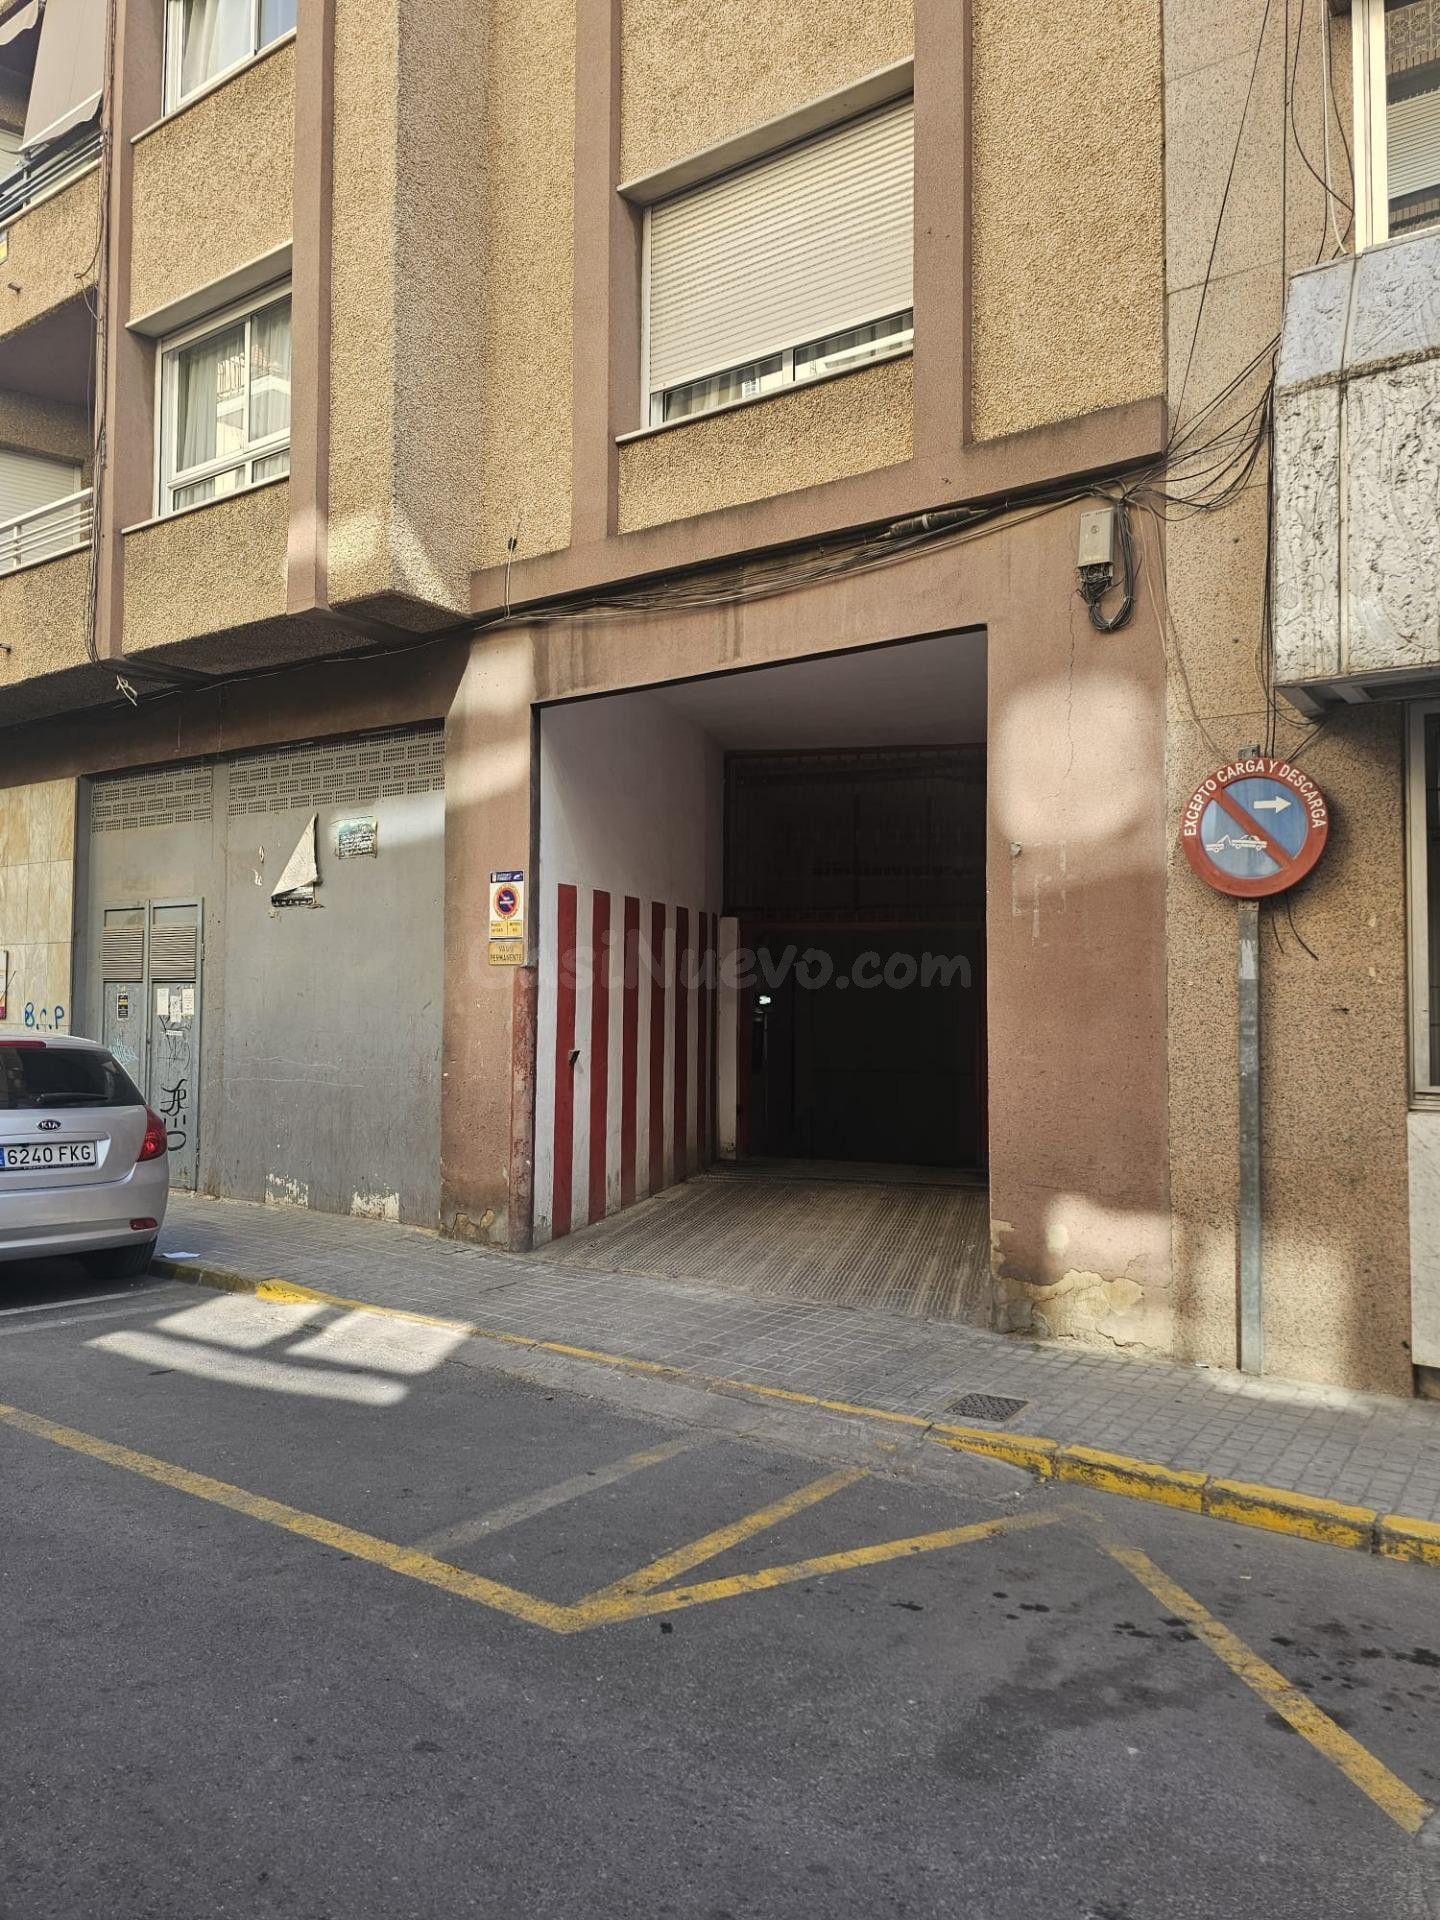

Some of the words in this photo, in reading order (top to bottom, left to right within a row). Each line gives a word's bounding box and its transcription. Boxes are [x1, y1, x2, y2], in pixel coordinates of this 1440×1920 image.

[1184, 779, 1217, 836] EXCEPTO
[1217, 759, 1265, 782] CARGA
[1268, 760, 1278, 773] Y
[1278, 764, 1327, 829] DESCARGA
[41, 1121, 58, 1130] KIA
[7, 1147, 53, 1165] 6240
[58, 1145, 91, 1162] FKG
